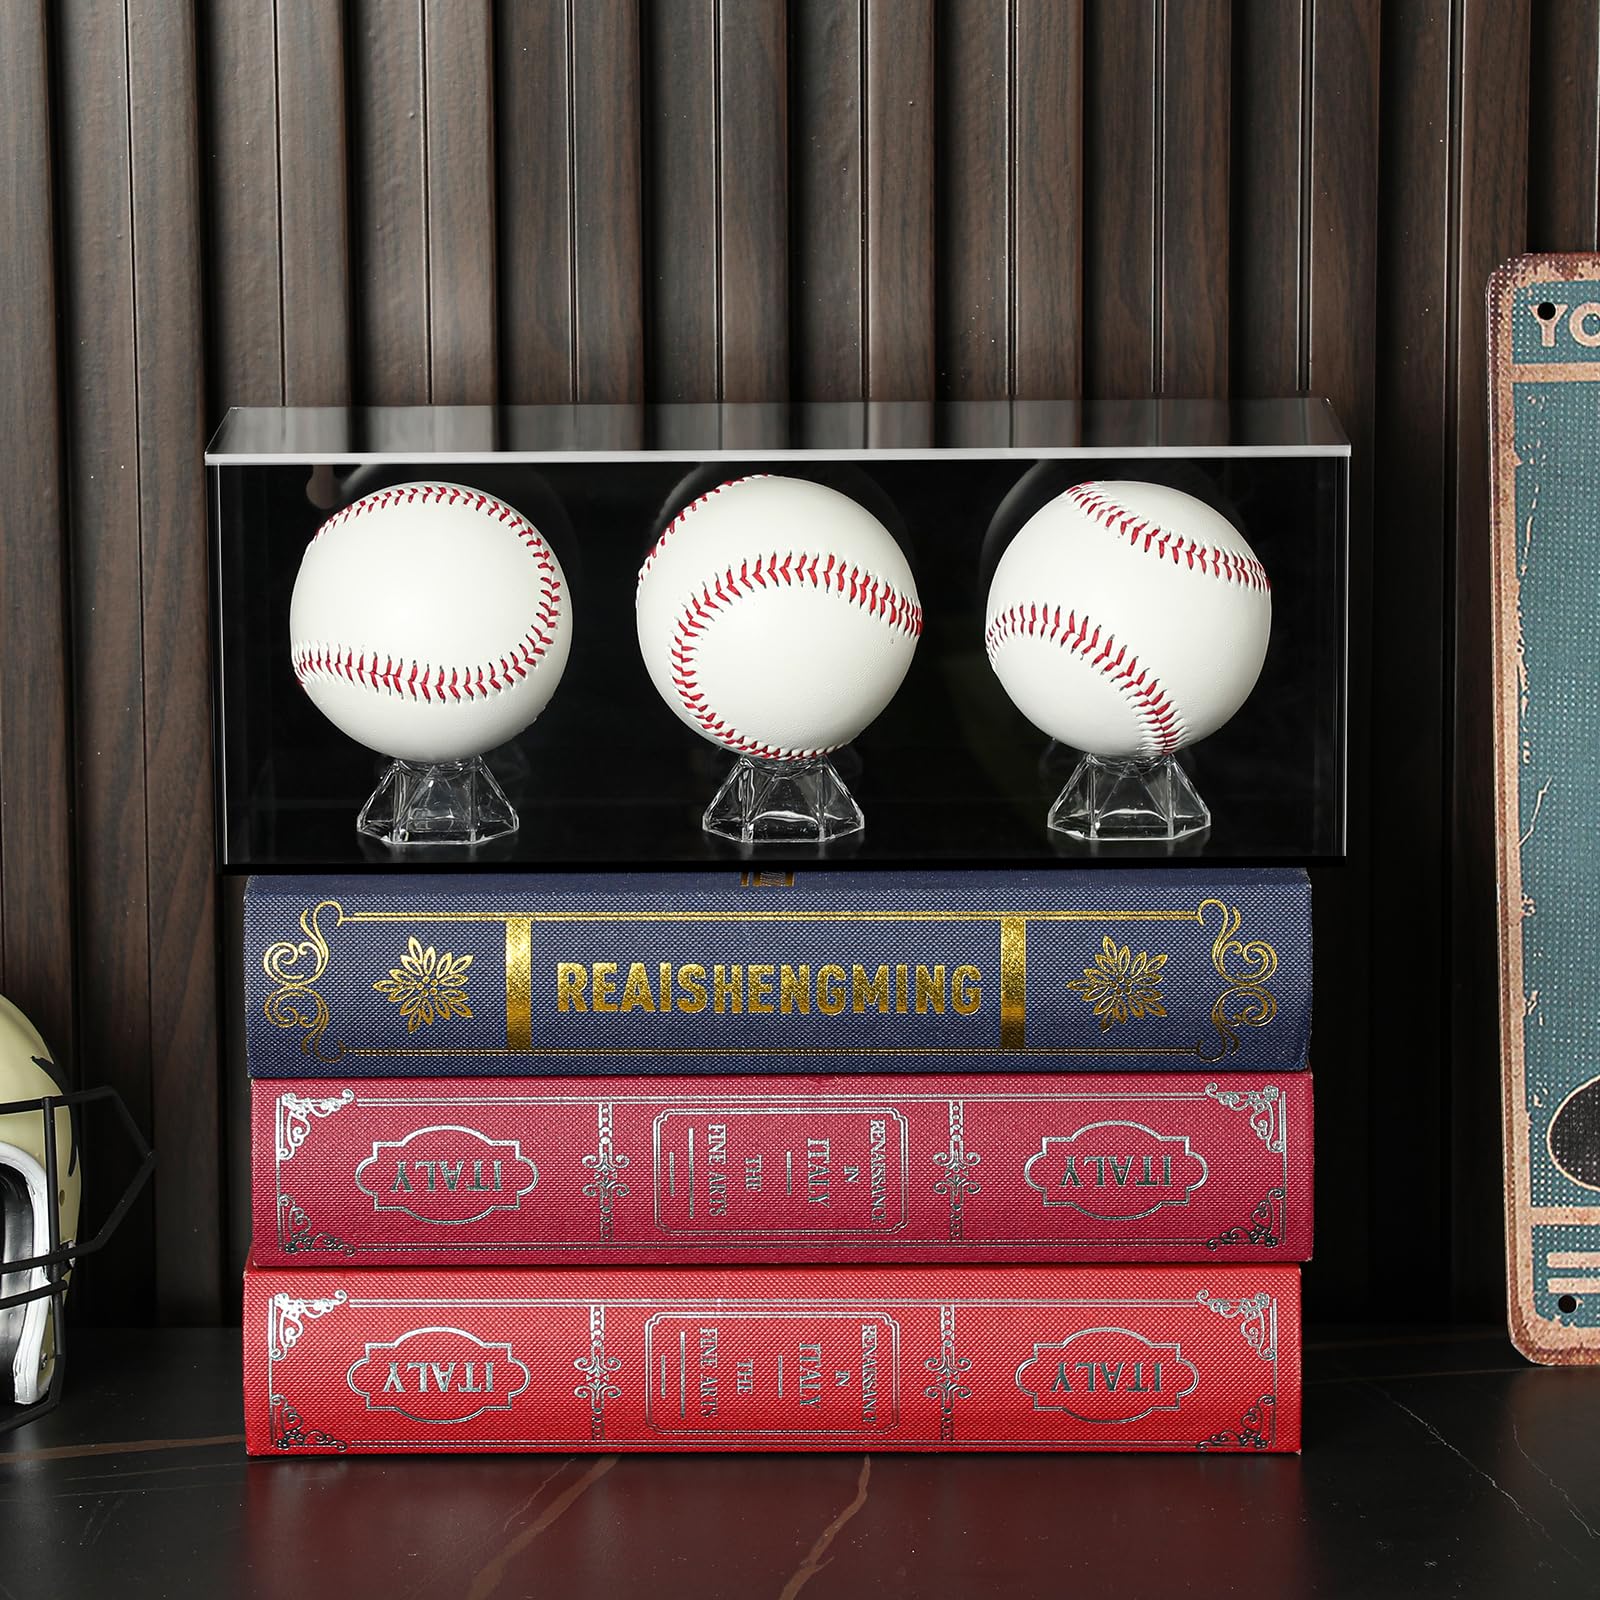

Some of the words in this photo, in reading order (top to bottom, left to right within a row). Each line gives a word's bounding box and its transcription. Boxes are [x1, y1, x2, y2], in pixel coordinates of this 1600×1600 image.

[556, 961, 982, 1015] REAISHENGMING
[708, 1123, 726, 1166] FINE
[390, 1159, 502, 1192] ITALY
[807, 1137, 830, 1208] ITALY
[1059, 1155, 1172, 1187] ITALY
[708, 1171, 727, 1217] ARTS
[700, 1327, 718, 1368] FINE
[382, 1361, 495, 1392] ITALY
[700, 1374, 718, 1418] ARTS
[737, 1357, 753, 1395] THE
[800, 1343, 821, 1409] ITALY
[835, 1370, 850, 1387] IN
[1051, 1361, 1162, 1392] ITALY
